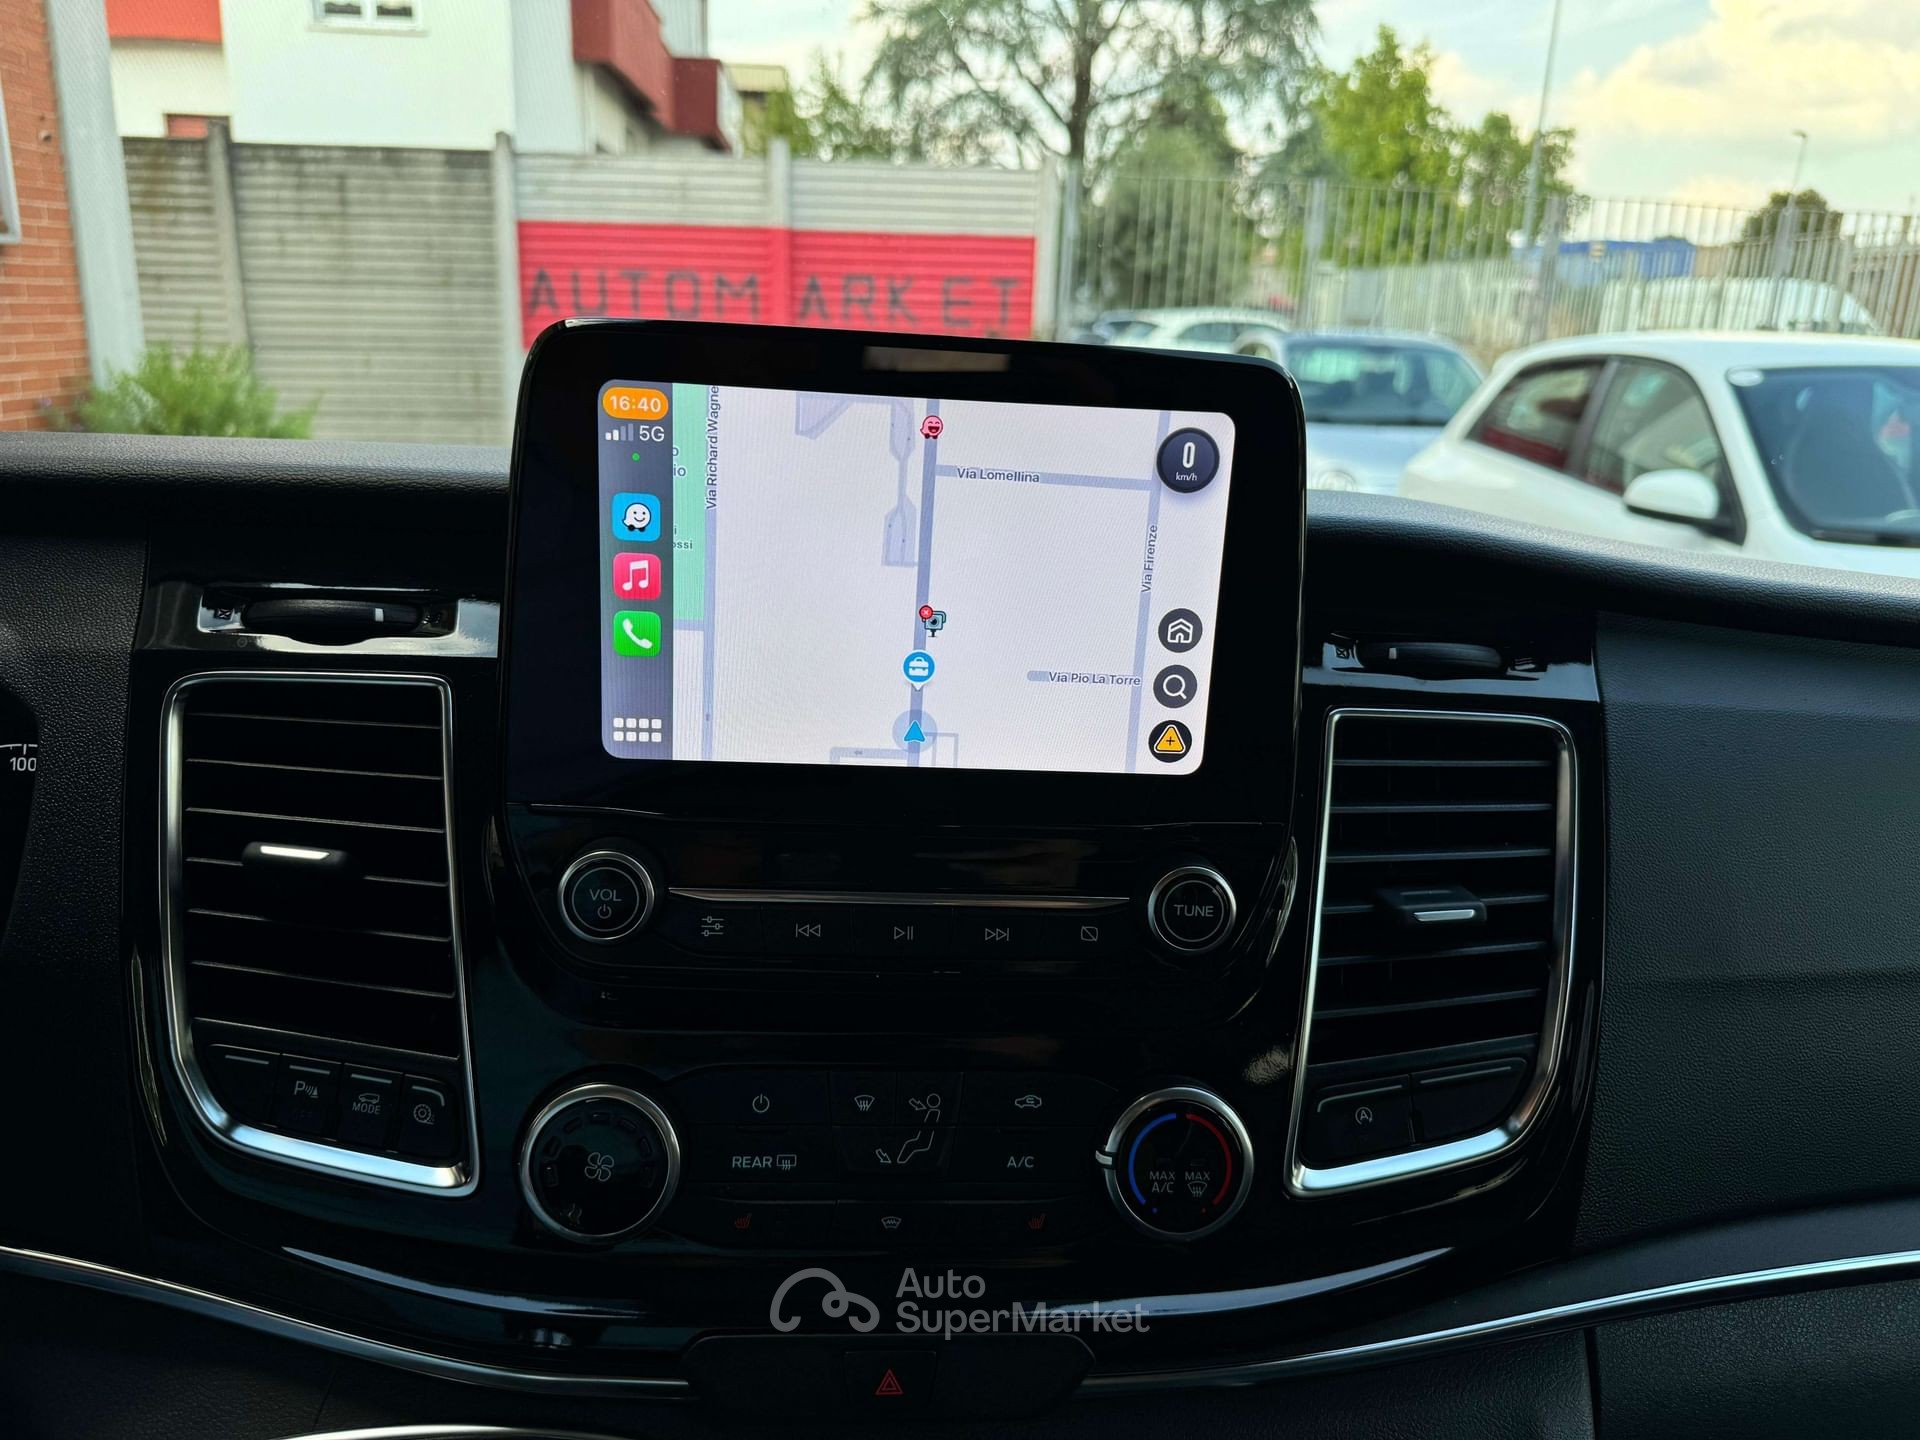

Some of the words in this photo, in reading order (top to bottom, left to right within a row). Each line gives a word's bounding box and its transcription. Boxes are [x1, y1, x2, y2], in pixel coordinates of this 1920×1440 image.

[609, 395, 661, 413] 16:40
[639, 425, 665, 442] 5G
[706, 434, 718, 487] Richard
[1182, 441, 1196, 469] 0
[957, 468, 977, 479] Via
[980, 468, 1040, 483] Lomellina
[1175, 472, 1198, 481] km/h
[706, 489, 717, 510] Via
[1144, 525, 1158, 571] Firenze
[1141, 572, 1153, 593] Via
[1049, 671, 1068, 683] Via
[1071, 673, 1090, 684] Pio
[1092, 674, 1106, 685] La
[1109, 674, 1141, 686] Torre
[9, 757, 37, 772] 100
[589, 888, 622, 901] VOL
[1173, 904, 1214, 918] TUNE
[352, 1102, 381, 1115] MODE
[731, 1155, 772, 1169] REAR
[1006, 1156, 1035, 1169] A/C
[1149, 1170, 1176, 1181] MAX
[1184, 1170, 1211, 1181] MAX
[1151, 1181, 1175, 1193] A/C
